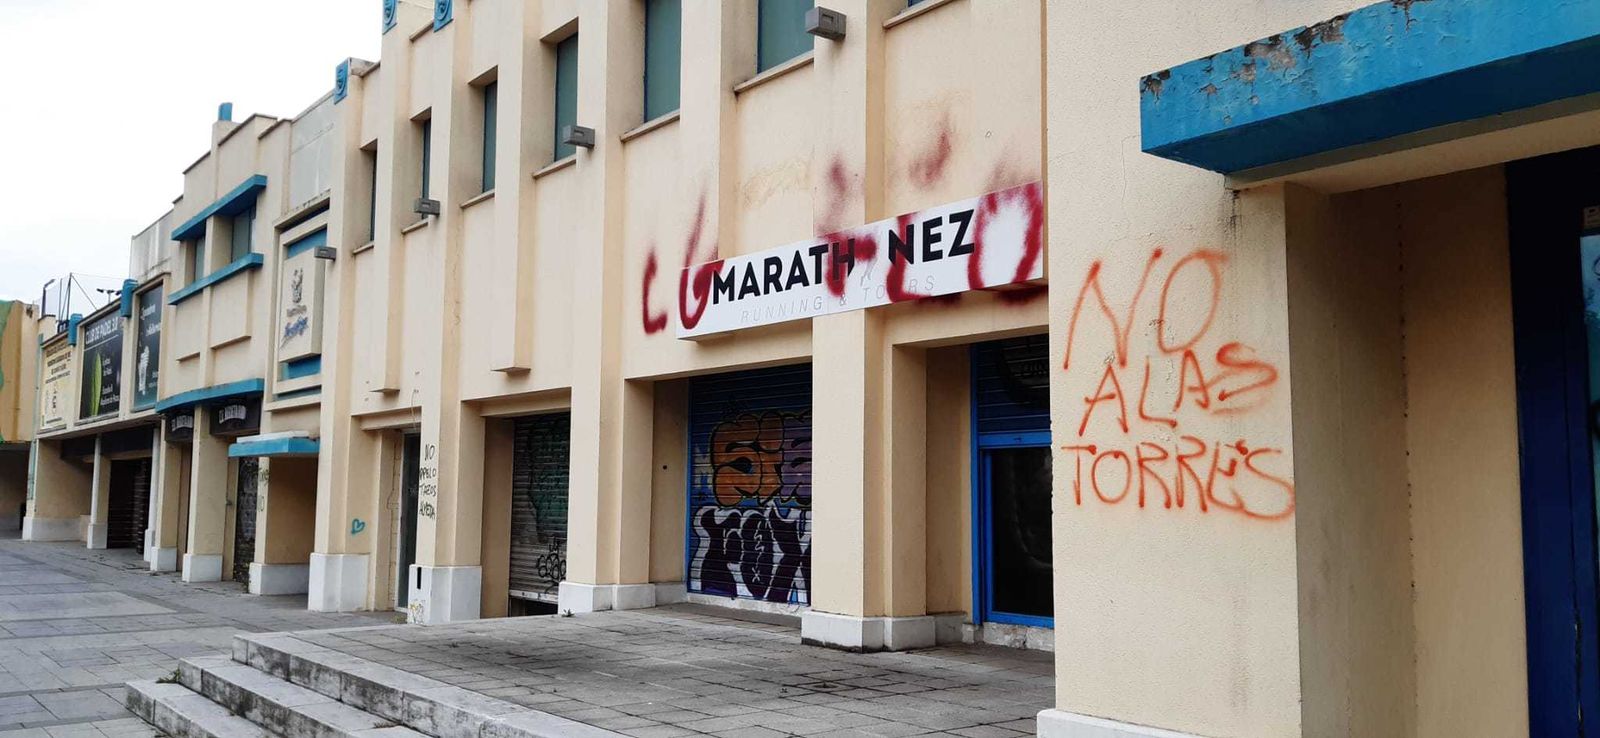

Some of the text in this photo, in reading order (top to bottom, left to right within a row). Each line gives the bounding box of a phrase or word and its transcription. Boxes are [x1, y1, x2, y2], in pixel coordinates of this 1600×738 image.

[741, 296, 824, 322] RUNNING
[862, 275, 935, 301] TORS
[1063, 247, 1226, 370] NO
[424, 443, 436, 461] NO
[1061, 435, 1296, 521] TORRES
